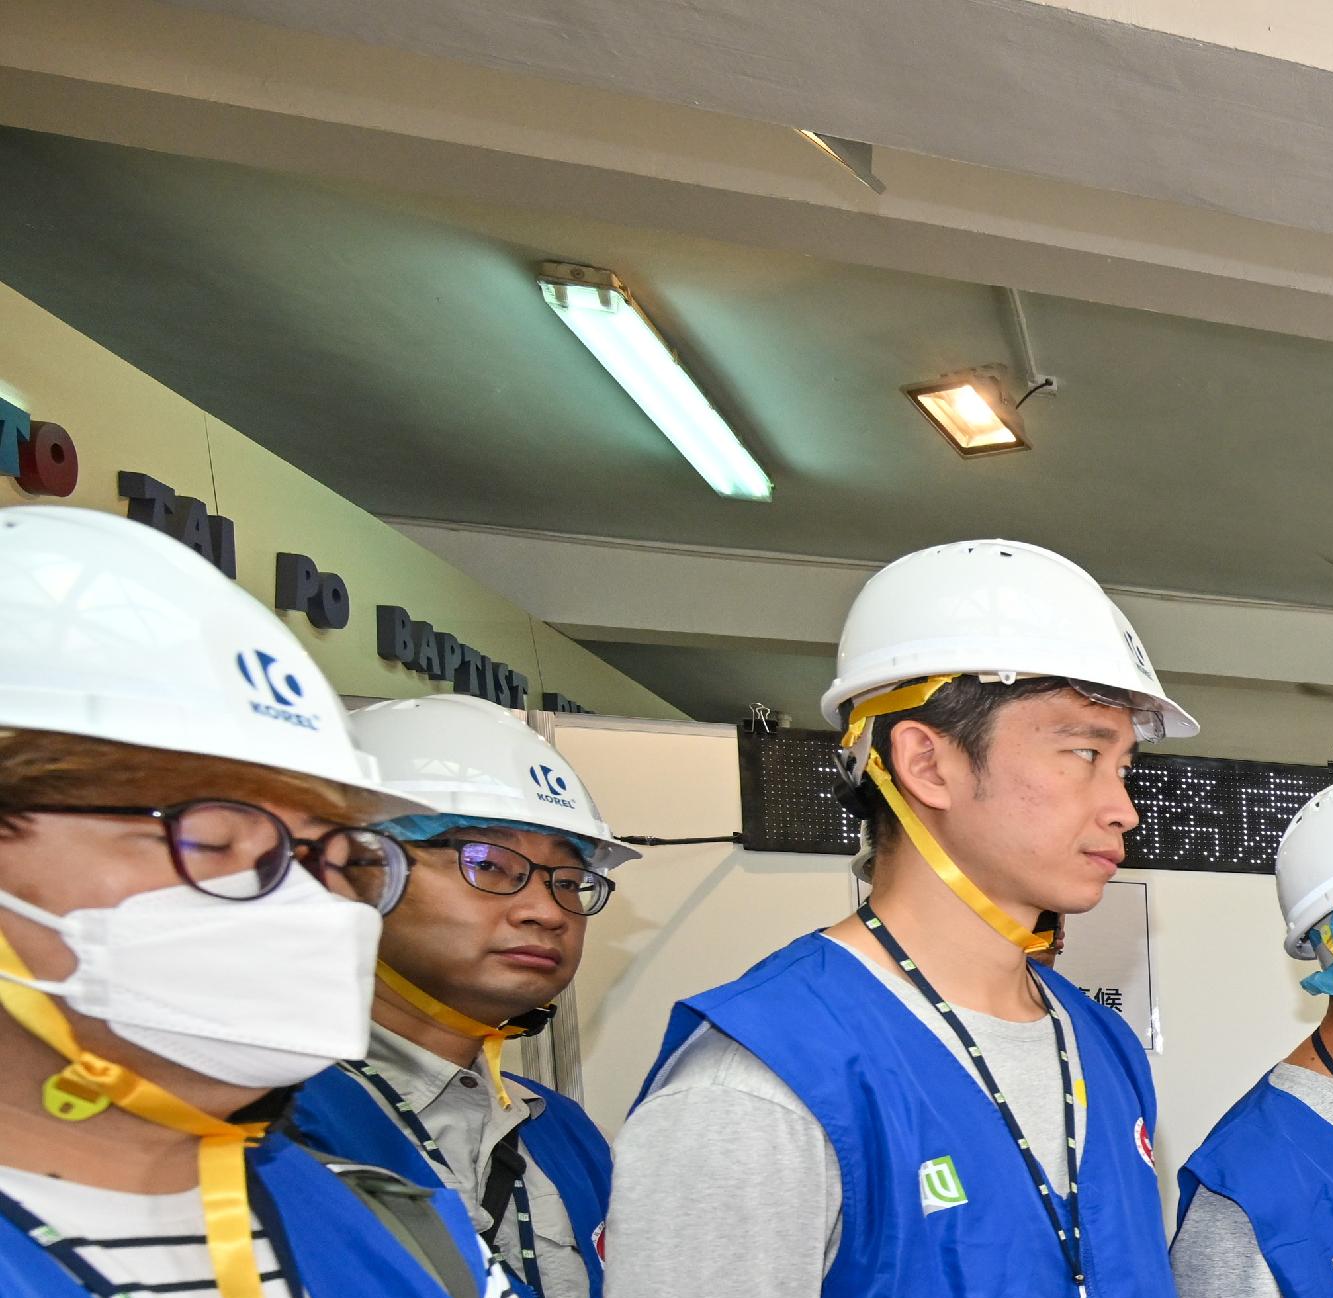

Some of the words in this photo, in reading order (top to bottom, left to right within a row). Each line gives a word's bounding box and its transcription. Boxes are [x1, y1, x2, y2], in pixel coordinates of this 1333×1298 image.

[118, 470, 237, 580] TAI
[275, 552, 350, 629] PO
[376, 604, 529, 711] BAPTIST
[536, 792, 575, 809] KOREL
